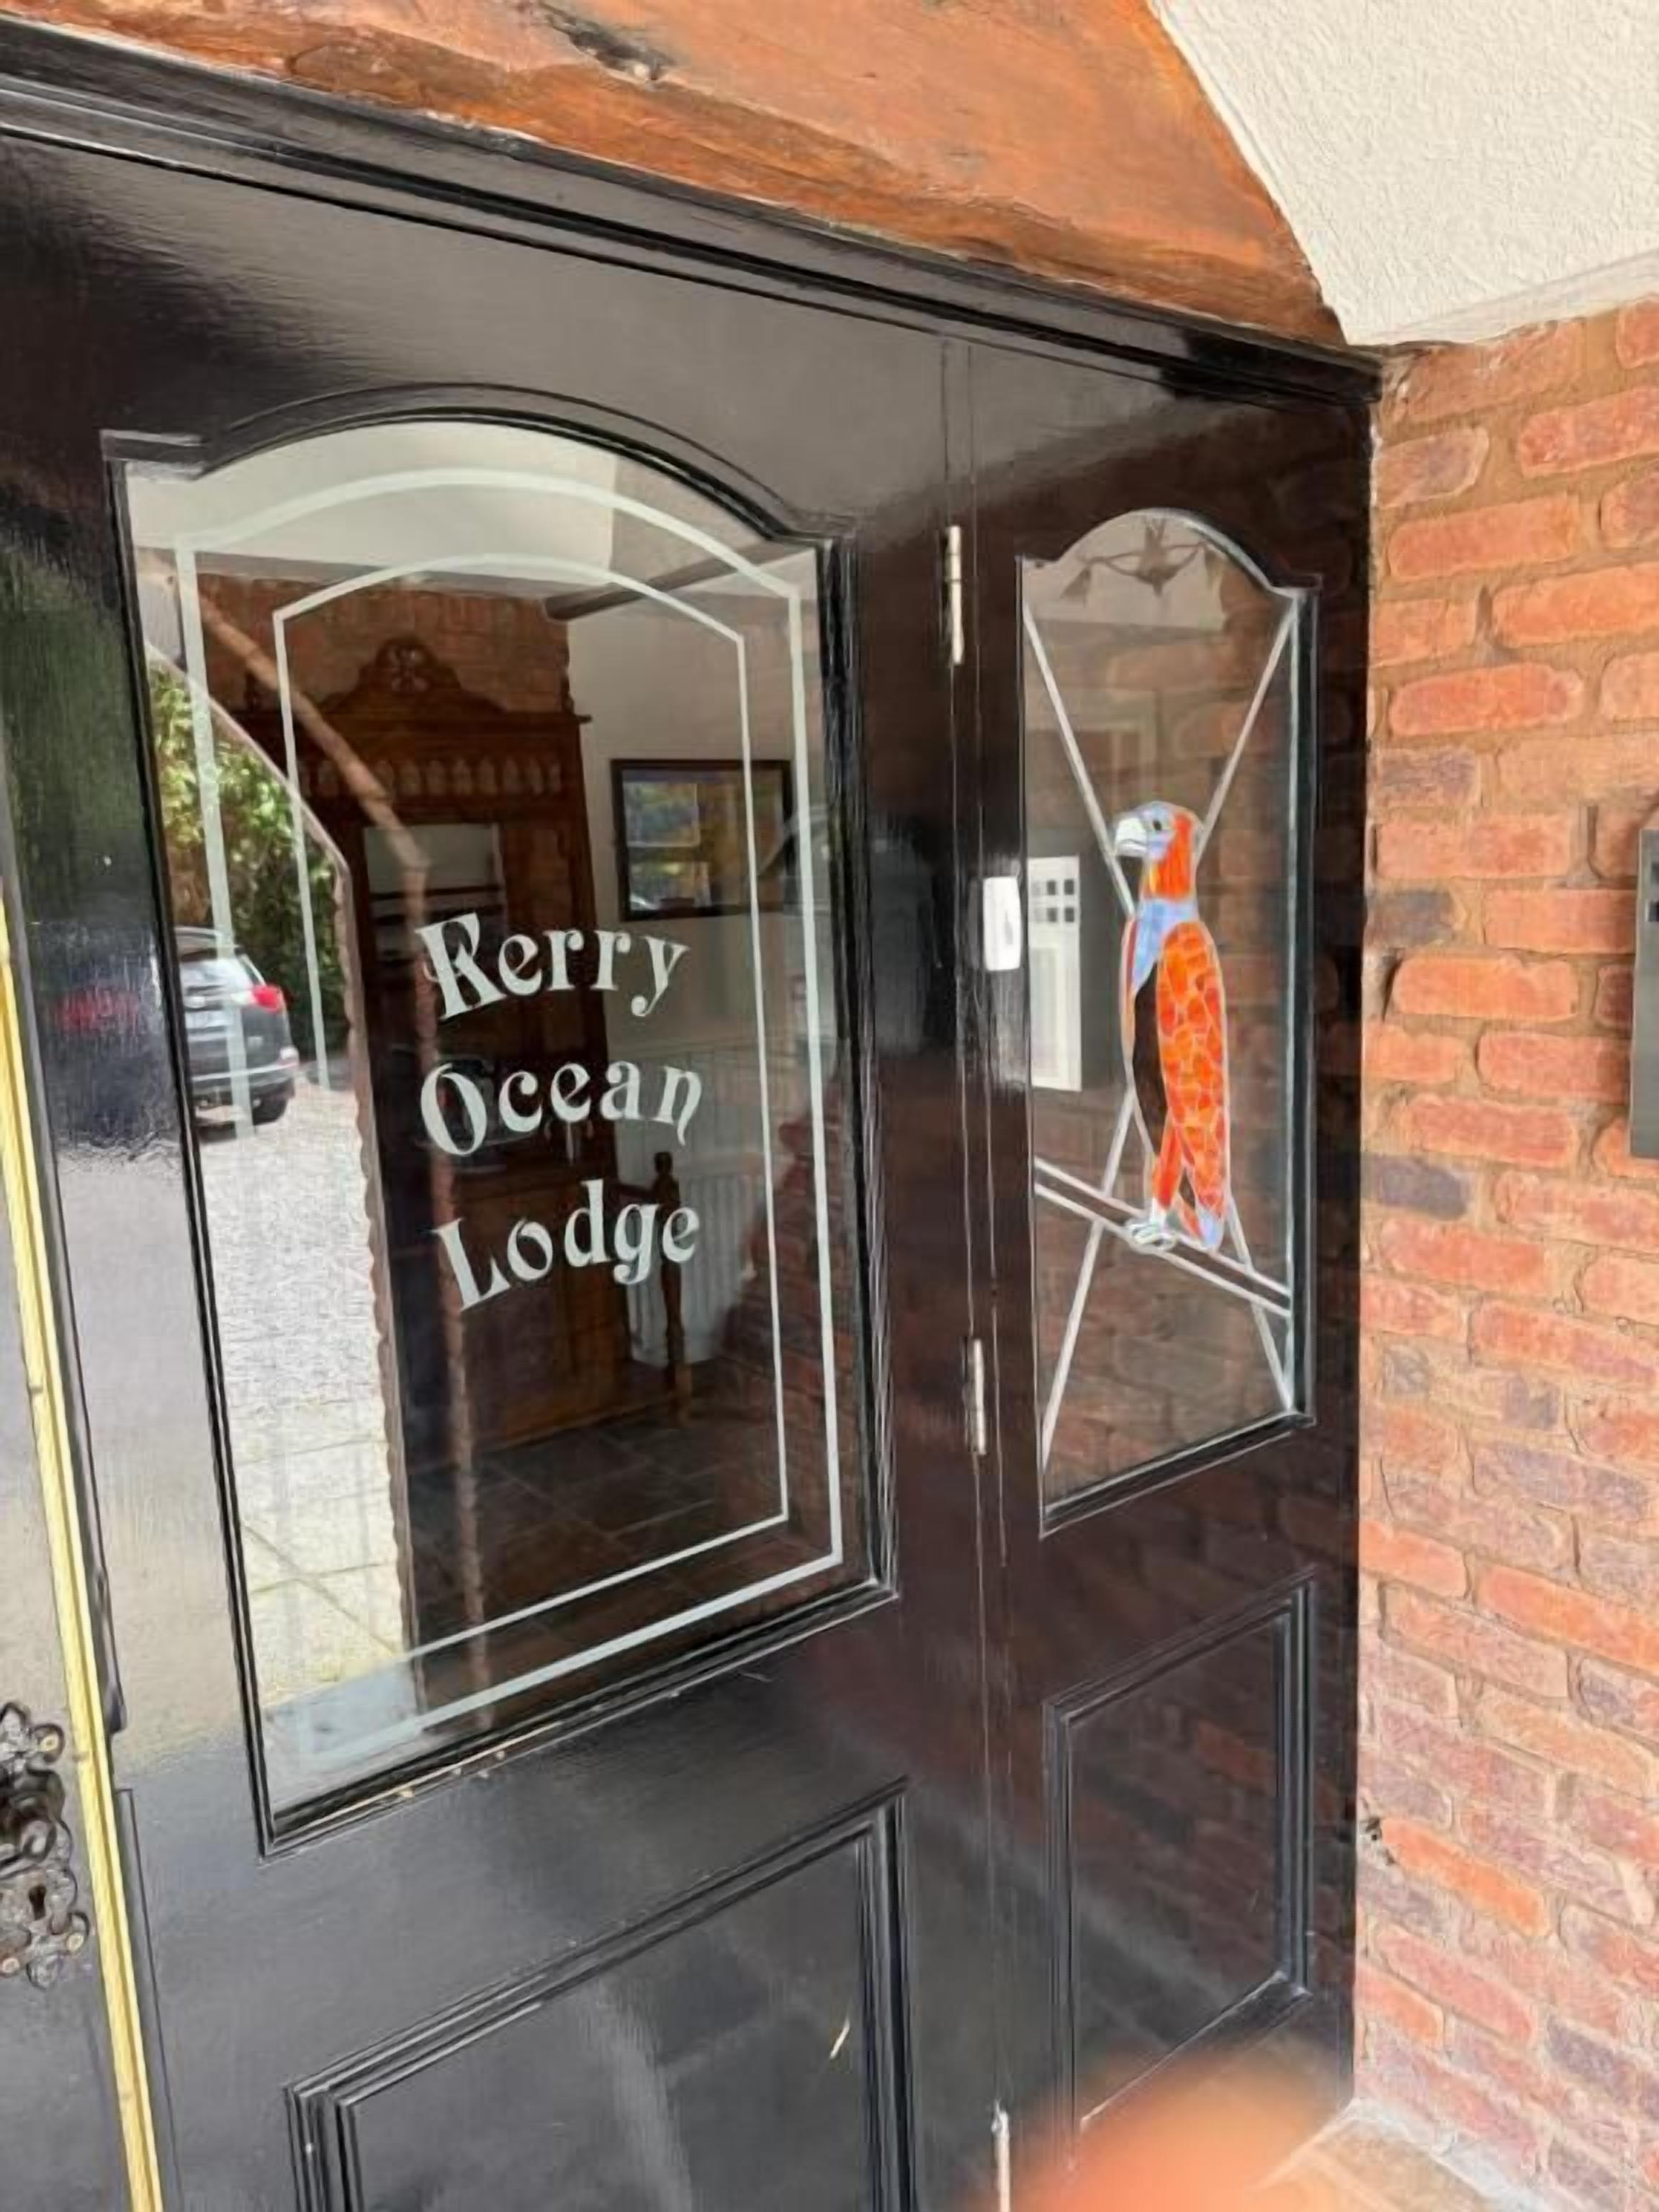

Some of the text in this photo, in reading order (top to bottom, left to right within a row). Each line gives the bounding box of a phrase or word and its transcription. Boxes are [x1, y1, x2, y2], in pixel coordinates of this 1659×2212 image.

[415, 912, 690, 1020] Kerry
[421, 1061, 702, 1156] Ocean
[431, 1178, 699, 1311] Lodge
